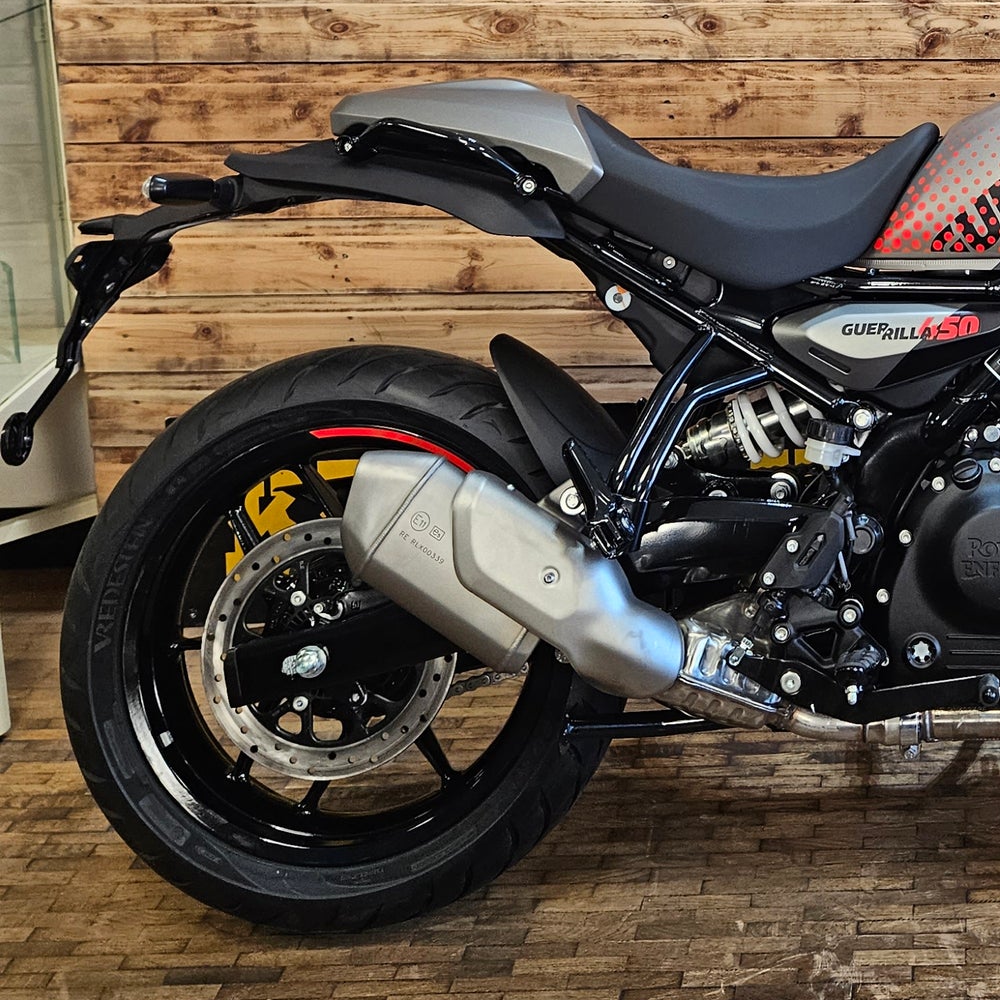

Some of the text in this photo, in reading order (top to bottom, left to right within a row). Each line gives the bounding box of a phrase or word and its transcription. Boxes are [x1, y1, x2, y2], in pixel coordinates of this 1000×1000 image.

[841, 315, 981, 341] GUERRILLA 450
[94, 520, 154, 653] VREDESTEIN
